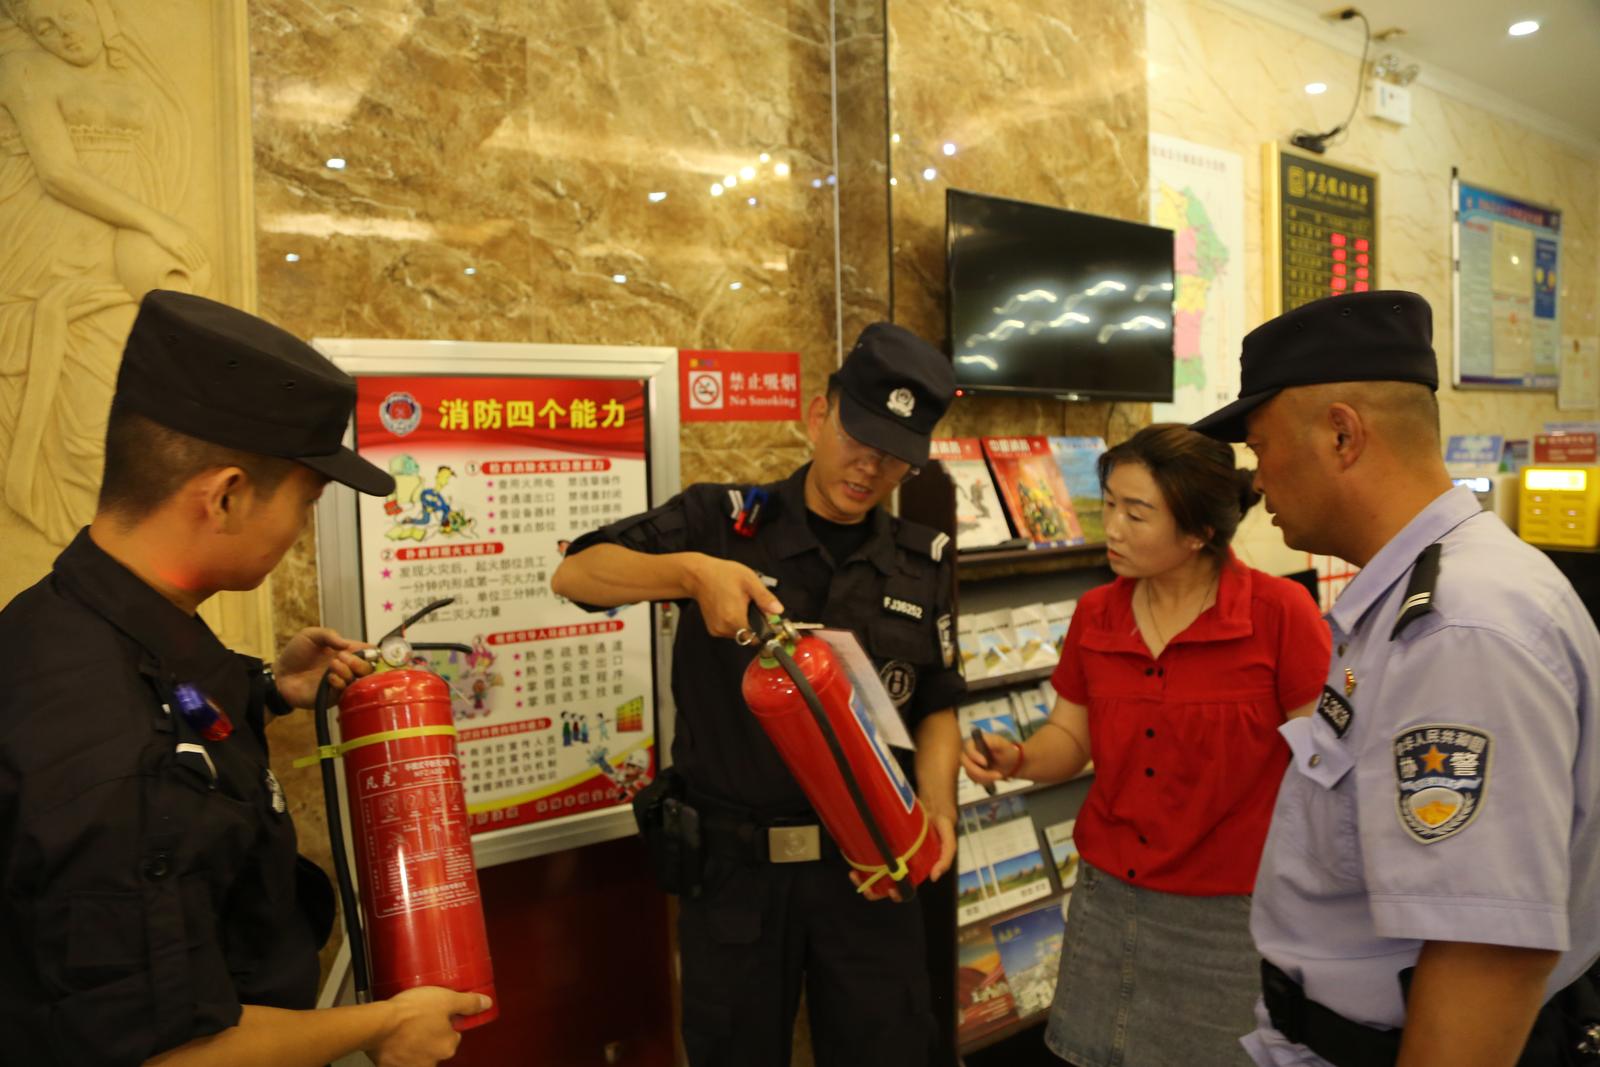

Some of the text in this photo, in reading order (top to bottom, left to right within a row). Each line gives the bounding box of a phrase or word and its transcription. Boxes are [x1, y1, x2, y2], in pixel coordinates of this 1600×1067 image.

[729, 371, 797, 391] 禁止吸烟
[729, 395, 797, 408] No Smoking
[438, 398, 625, 429] 消防四个能力
[499, 492, 555, 504] 查通道出口
[500, 521, 556, 534] 查重点部位
[400, 571, 546, 592] 一分钟内形成第一灭火力量
[526, 640, 622, 660] 熟悉疏散通道
[526, 656, 623, 675] 熟悉安全出口
[527, 670, 623, 692] 掌握疏散程序
[470, 735, 555, 756] 有消防宣传人员
[472, 771, 556, 793] 掌握消防安全知识
